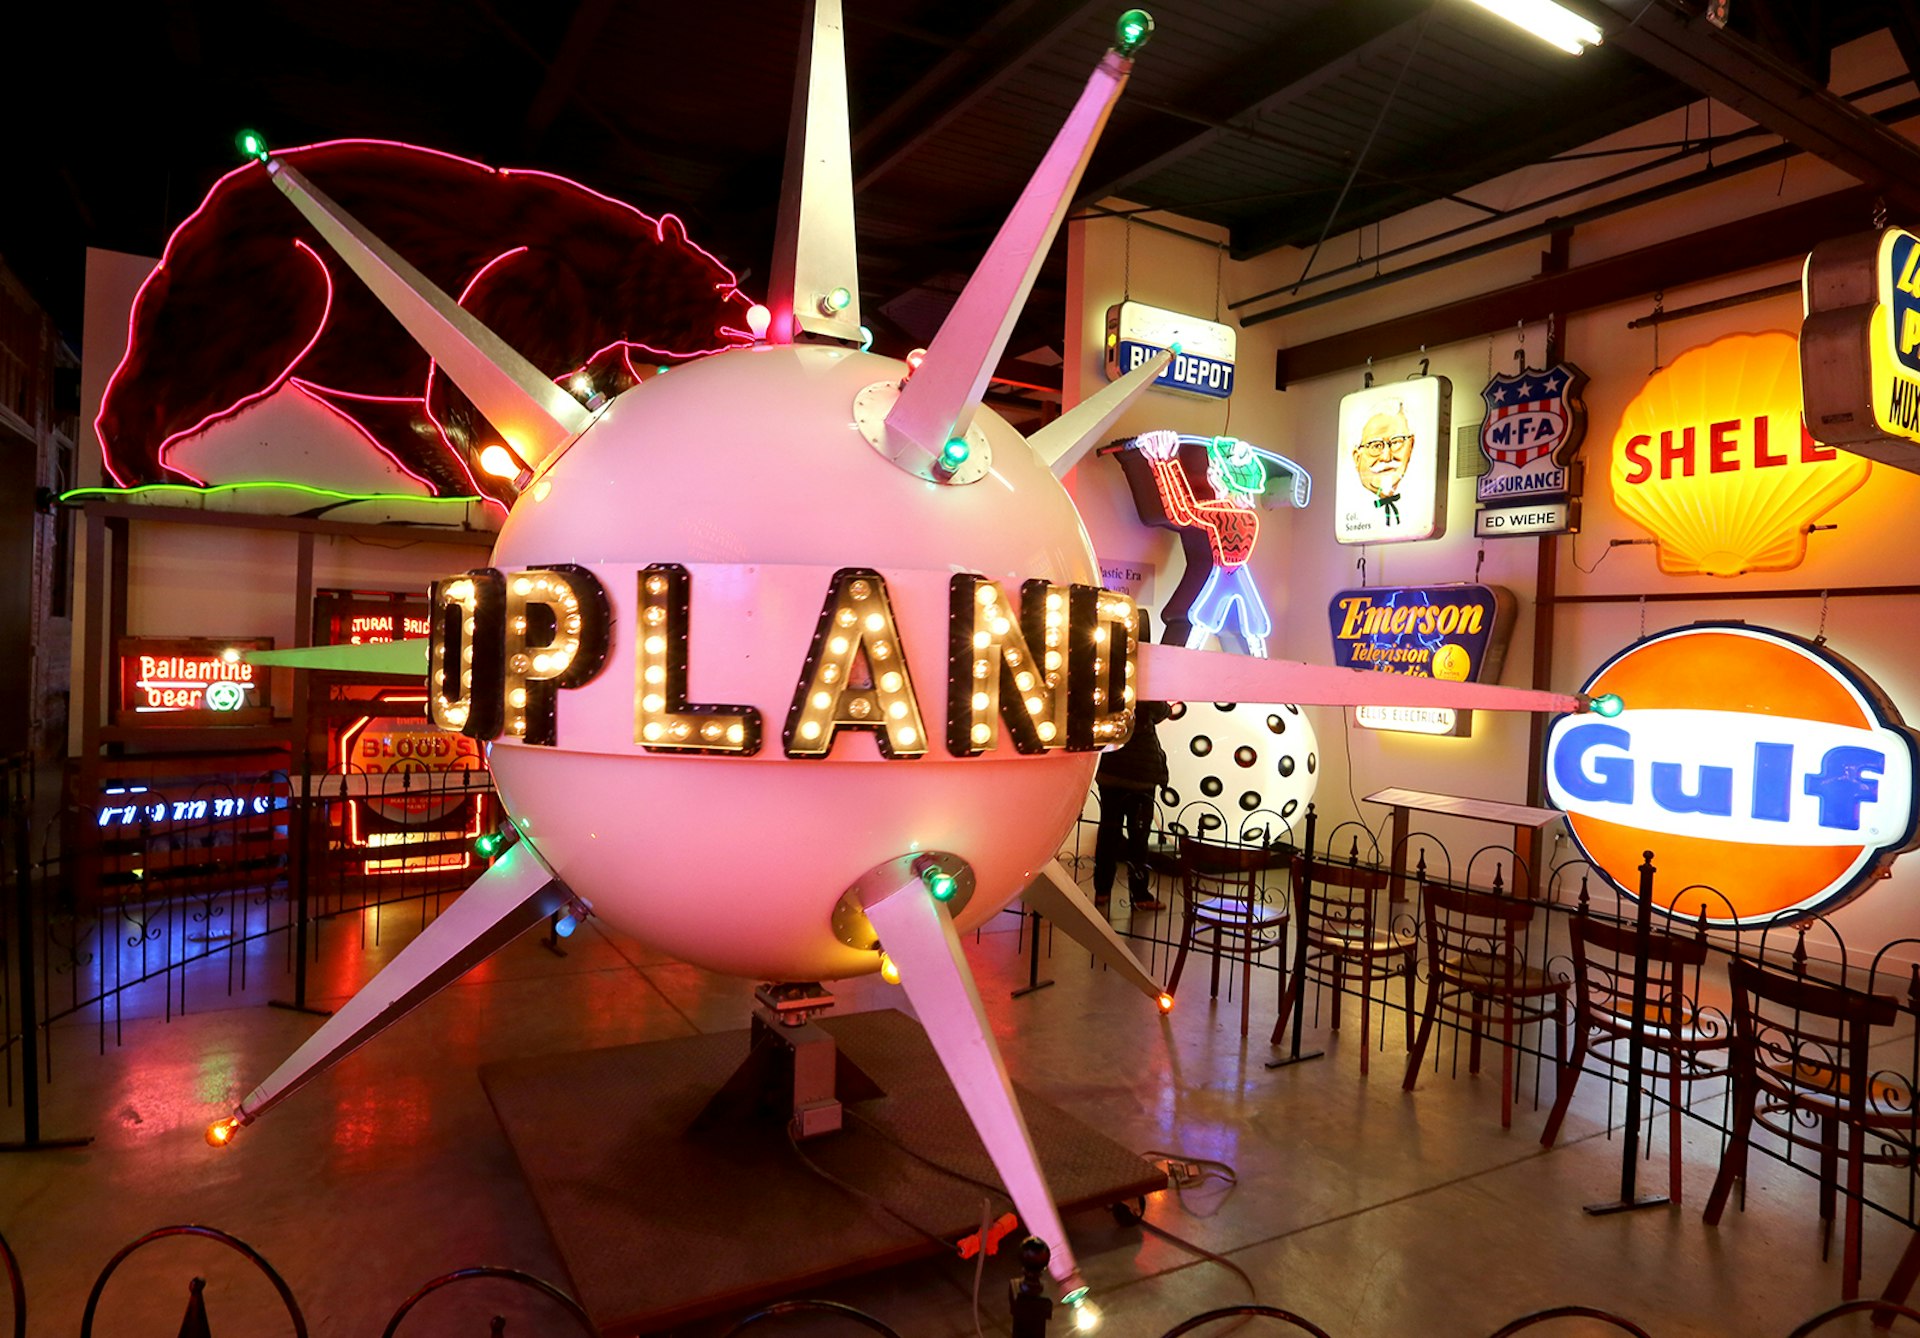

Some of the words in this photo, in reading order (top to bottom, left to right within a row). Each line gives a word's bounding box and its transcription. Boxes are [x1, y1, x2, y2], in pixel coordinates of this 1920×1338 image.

[1174, 355, 1233, 390] DEPOT
[1625, 411, 1837, 484] SHELL
[1484, 470, 1561, 494] INSURANCE
[1485, 516, 1505, 528] ED
[1510, 512, 1556, 526] WIEHE
[1126, 569, 1142, 581] Era
[1337, 597, 1485, 640] Emerson
[1351, 642, 1430, 663] Television
[140, 656, 253, 681] Ballantine
[145, 679, 203, 707] beer
[1360, 706, 1387, 720] ELLIS
[1392, 709, 1450, 726] ELECTRICAL
[362, 736, 472, 758] BLOOD'S
[1554, 723, 1886, 831] Gulf
